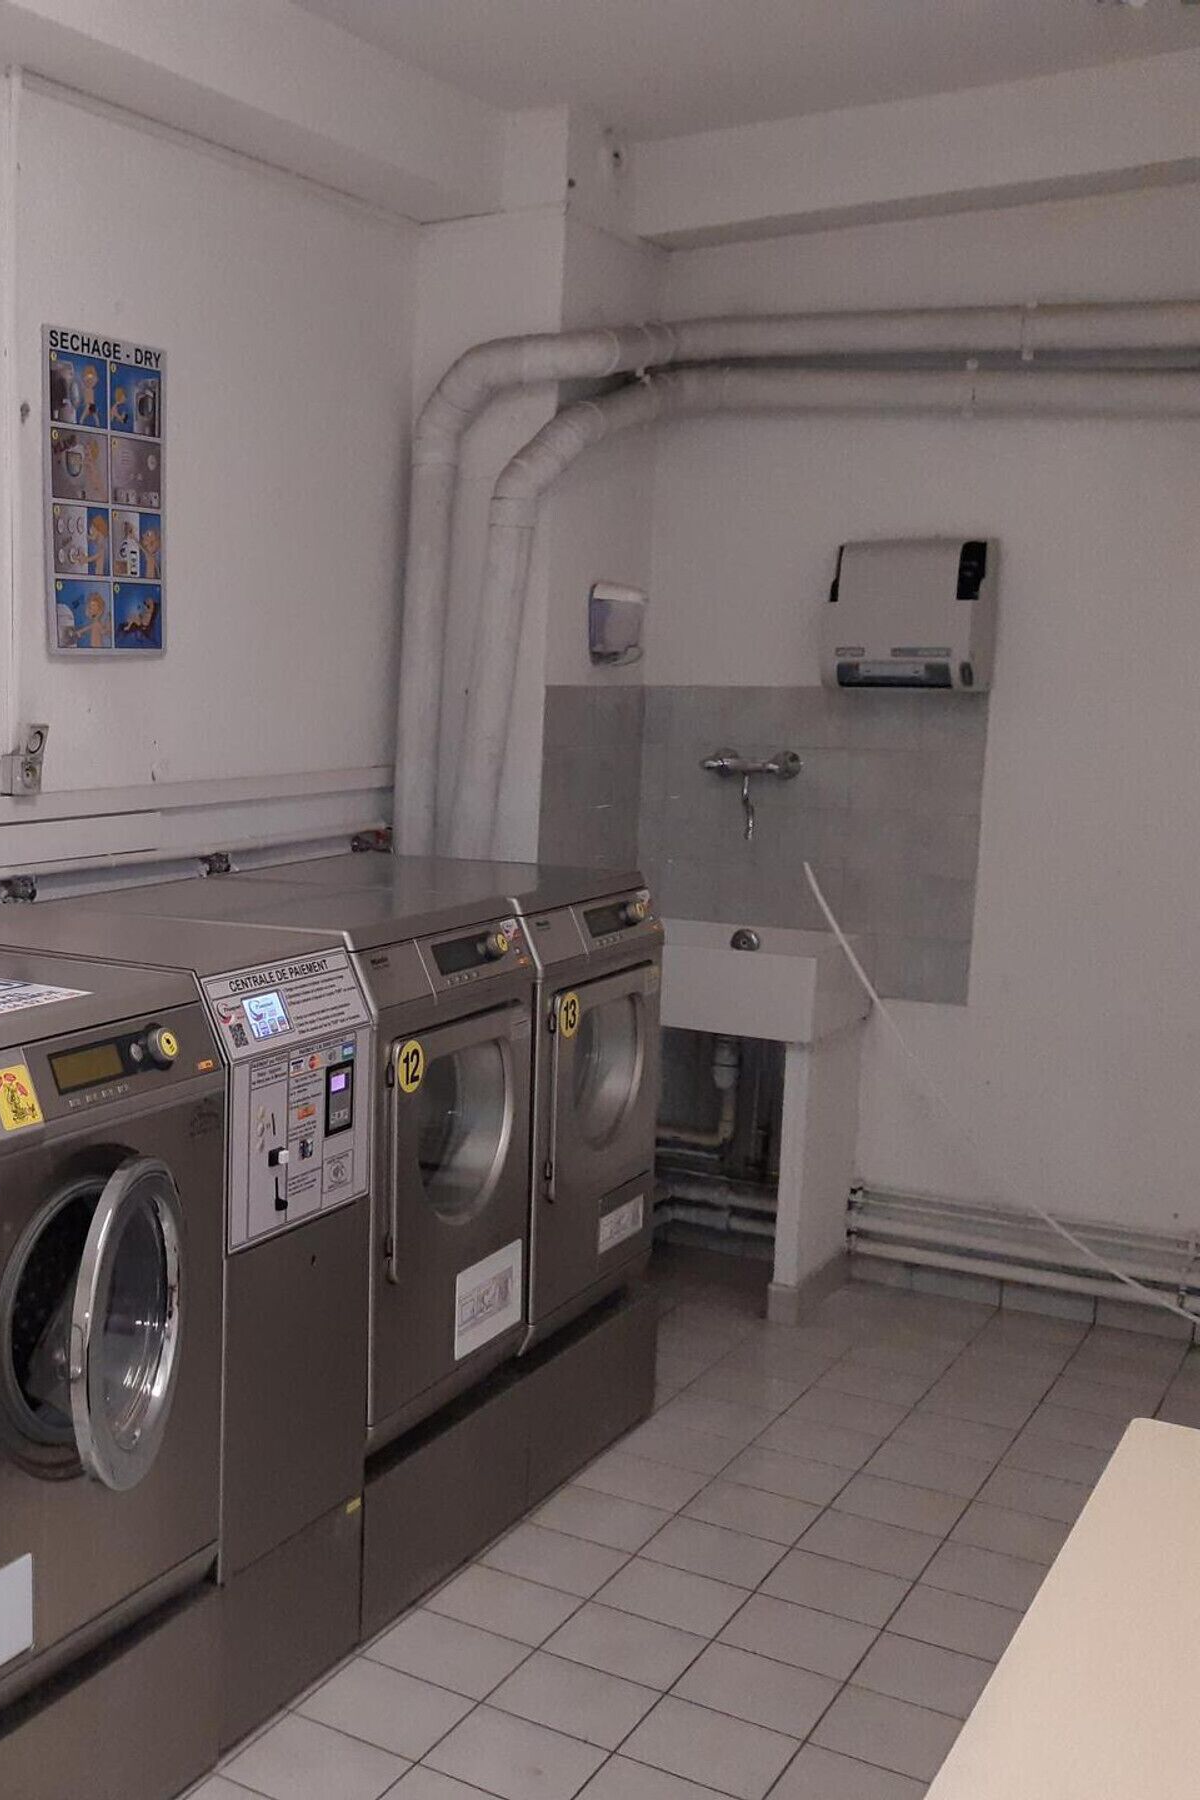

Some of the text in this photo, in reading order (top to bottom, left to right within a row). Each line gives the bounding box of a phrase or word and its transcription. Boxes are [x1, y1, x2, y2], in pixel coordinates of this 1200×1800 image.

[49, 330, 122, 361] SECHAGE
[135, 348, 162, 369] DRY
[228, 971, 276, 992] CENTRALE
[275, 968, 290, 982] DE
[289, 959, 329, 978] PAIEMENT
[562, 999, 577, 1031] 13
[402, 1048, 420, 1085] 12
